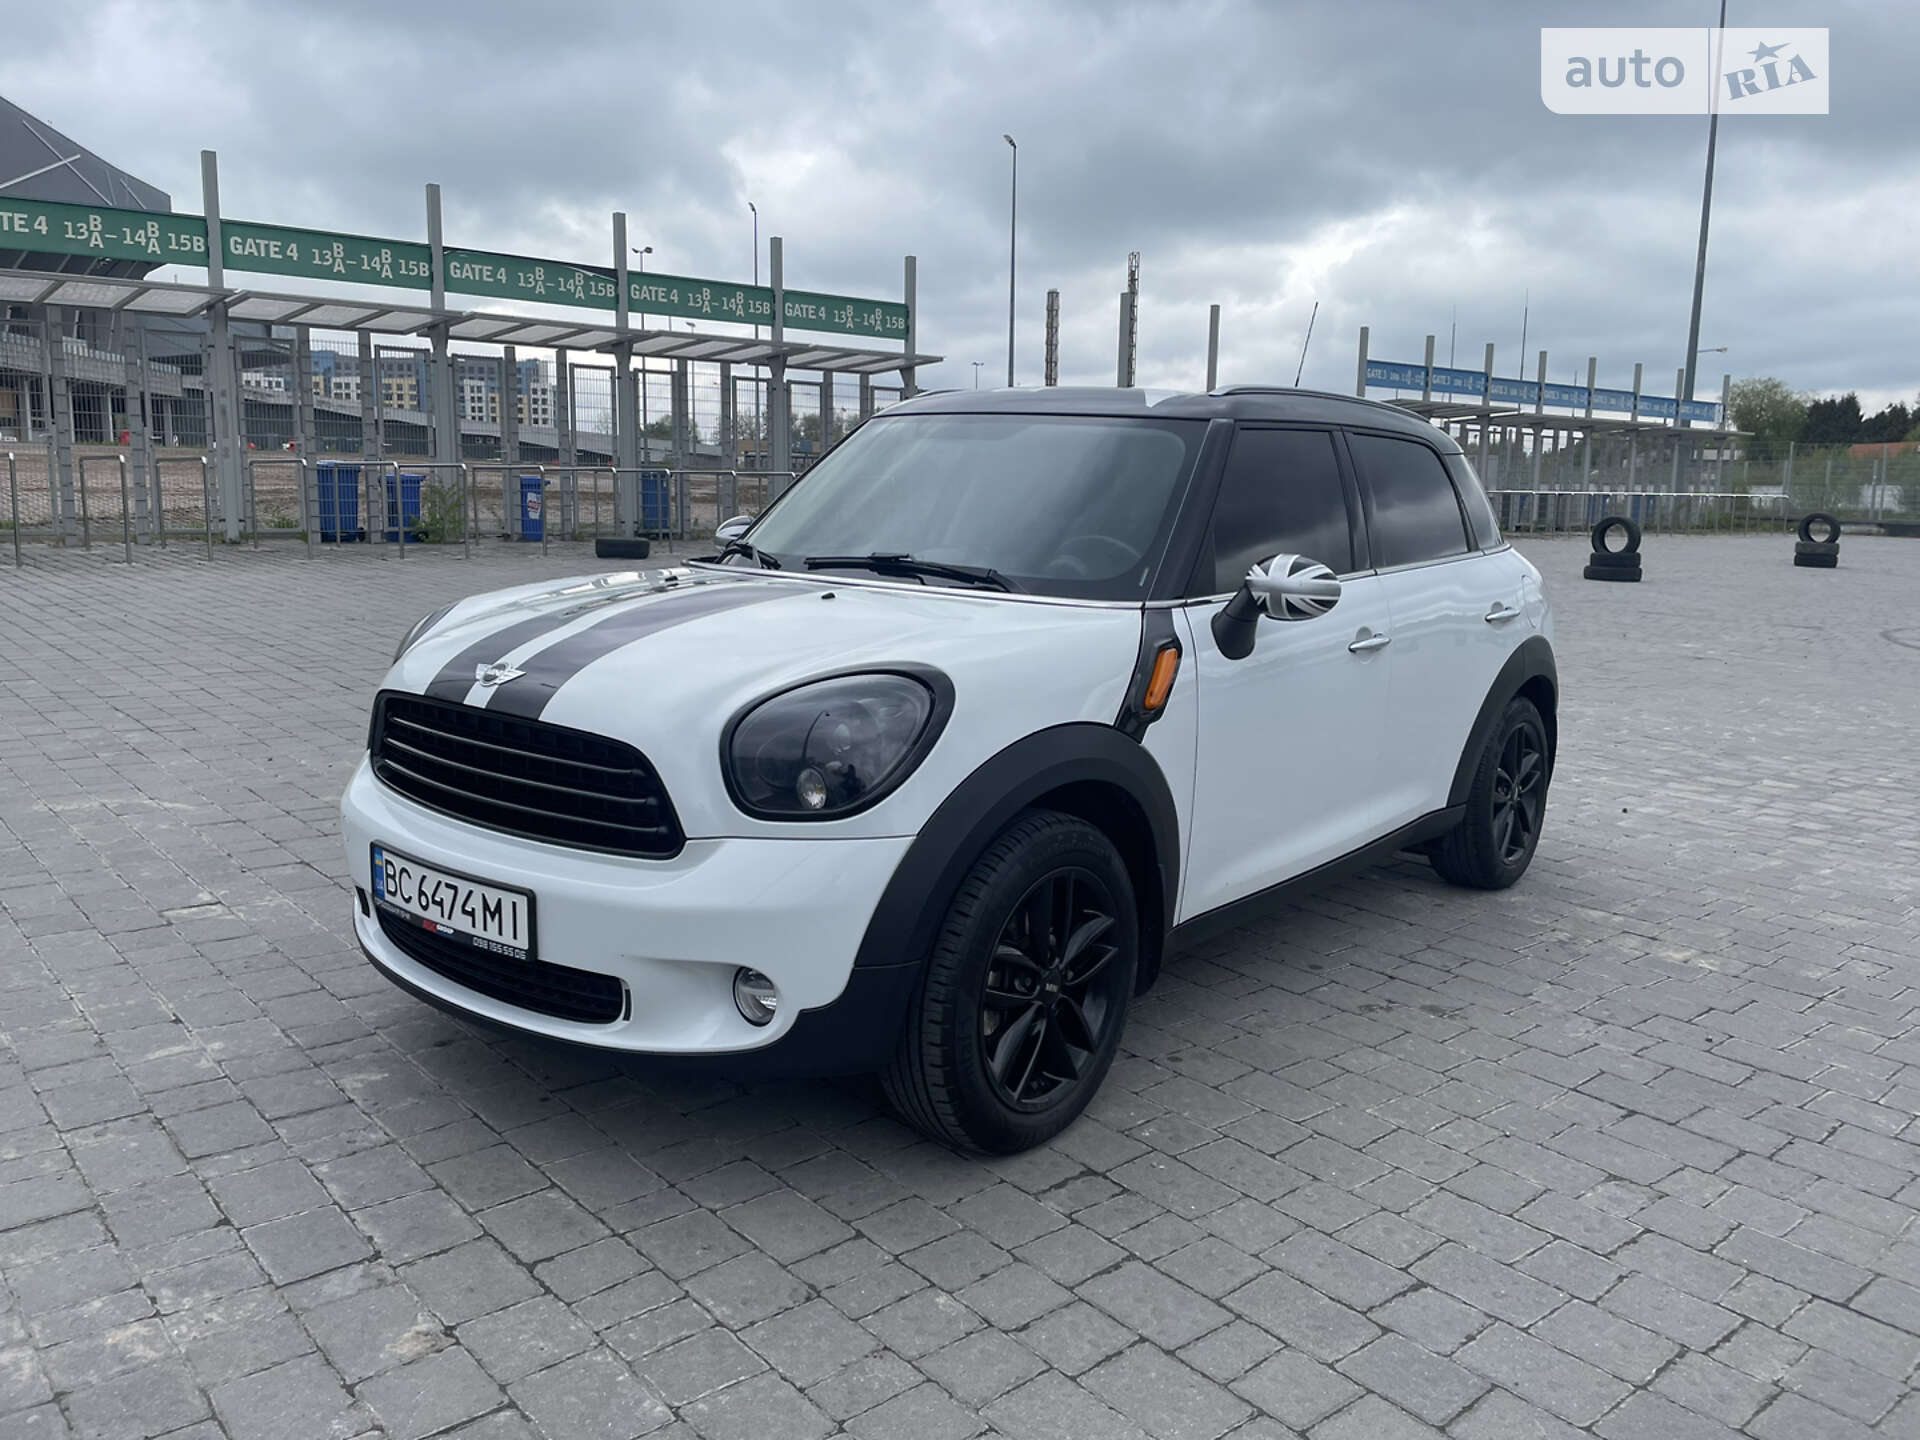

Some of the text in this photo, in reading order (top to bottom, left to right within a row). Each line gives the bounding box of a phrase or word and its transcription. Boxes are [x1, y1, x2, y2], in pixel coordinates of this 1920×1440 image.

[34, 215, 48, 235] 4
[167, 233, 205, 252] 15B
[229, 236, 283, 259] GATE
[286, 243, 299, 261] 4
[399, 259, 430, 277] 15B
[450, 261, 494, 282] GATE
[496, 267, 507, 284] 4
[589, 281, 616, 297] 15B
[630, 284, 668, 302] GATE
[669, 289, 679, 304] 4
[748, 300, 771, 315] 15B
[784, 302, 817, 320] GATE
